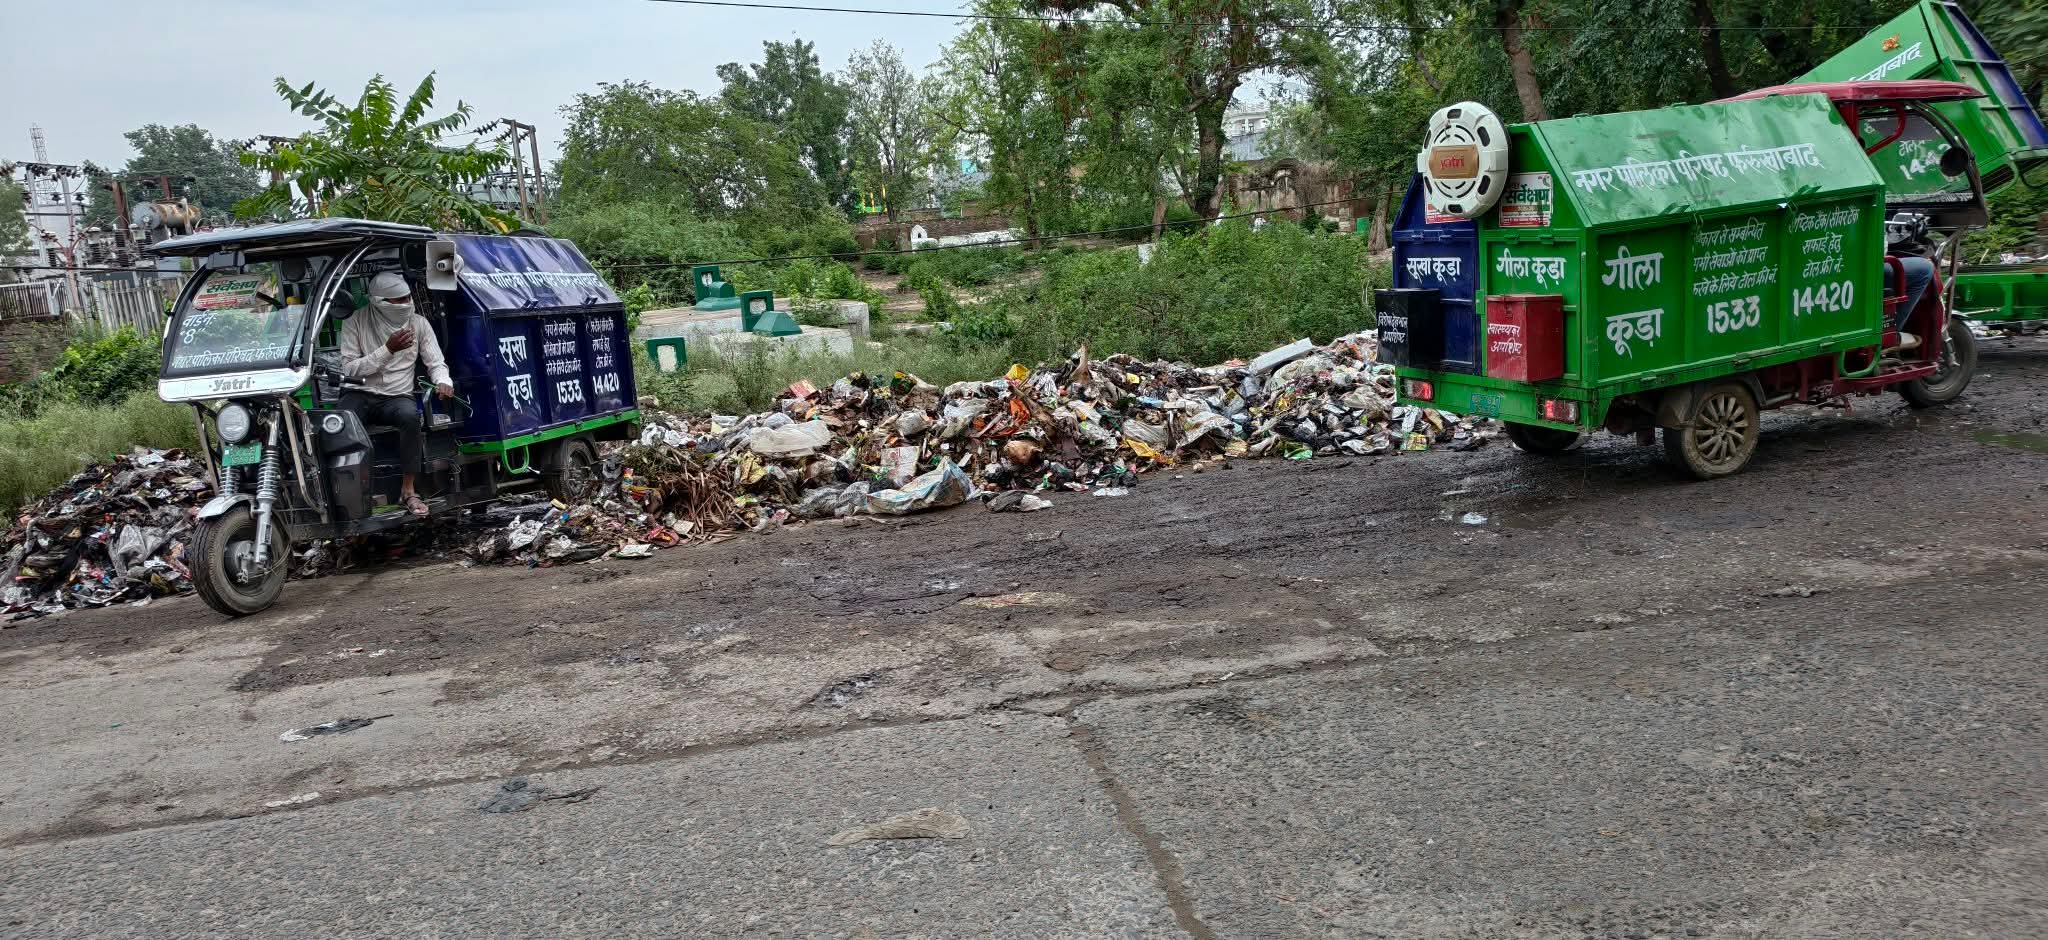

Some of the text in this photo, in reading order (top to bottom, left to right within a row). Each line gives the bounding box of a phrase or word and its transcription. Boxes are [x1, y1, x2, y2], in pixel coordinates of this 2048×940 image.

[1571, 168, 1621, 193] नगर
[1612, 156, 1679, 191] पालिका
[1671, 150, 1736, 183] परिषद
[1802, 232, 1830, 255] सफाई
[1406, 257, 1461, 286] सूखा कूड़ा
[1496, 248, 1566, 289] गीला कूड़ा
[1602, 245, 1664, 290] गीला
[1709, 275, 1720, 294] के
[1803, 259, 1821, 278] टोल
[1707, 295, 1760, 334] 1533
[1792, 280, 1854, 317] 14420
[1605, 308, 1664, 359] कूड़ा
[498, 335, 528, 371] सूखा
[212, 377, 251, 392] Yatri
[506, 373, 534, 414] कूड़ा
[557, 379, 582, 404] 1533
[592, 372, 620, 395] 14420
